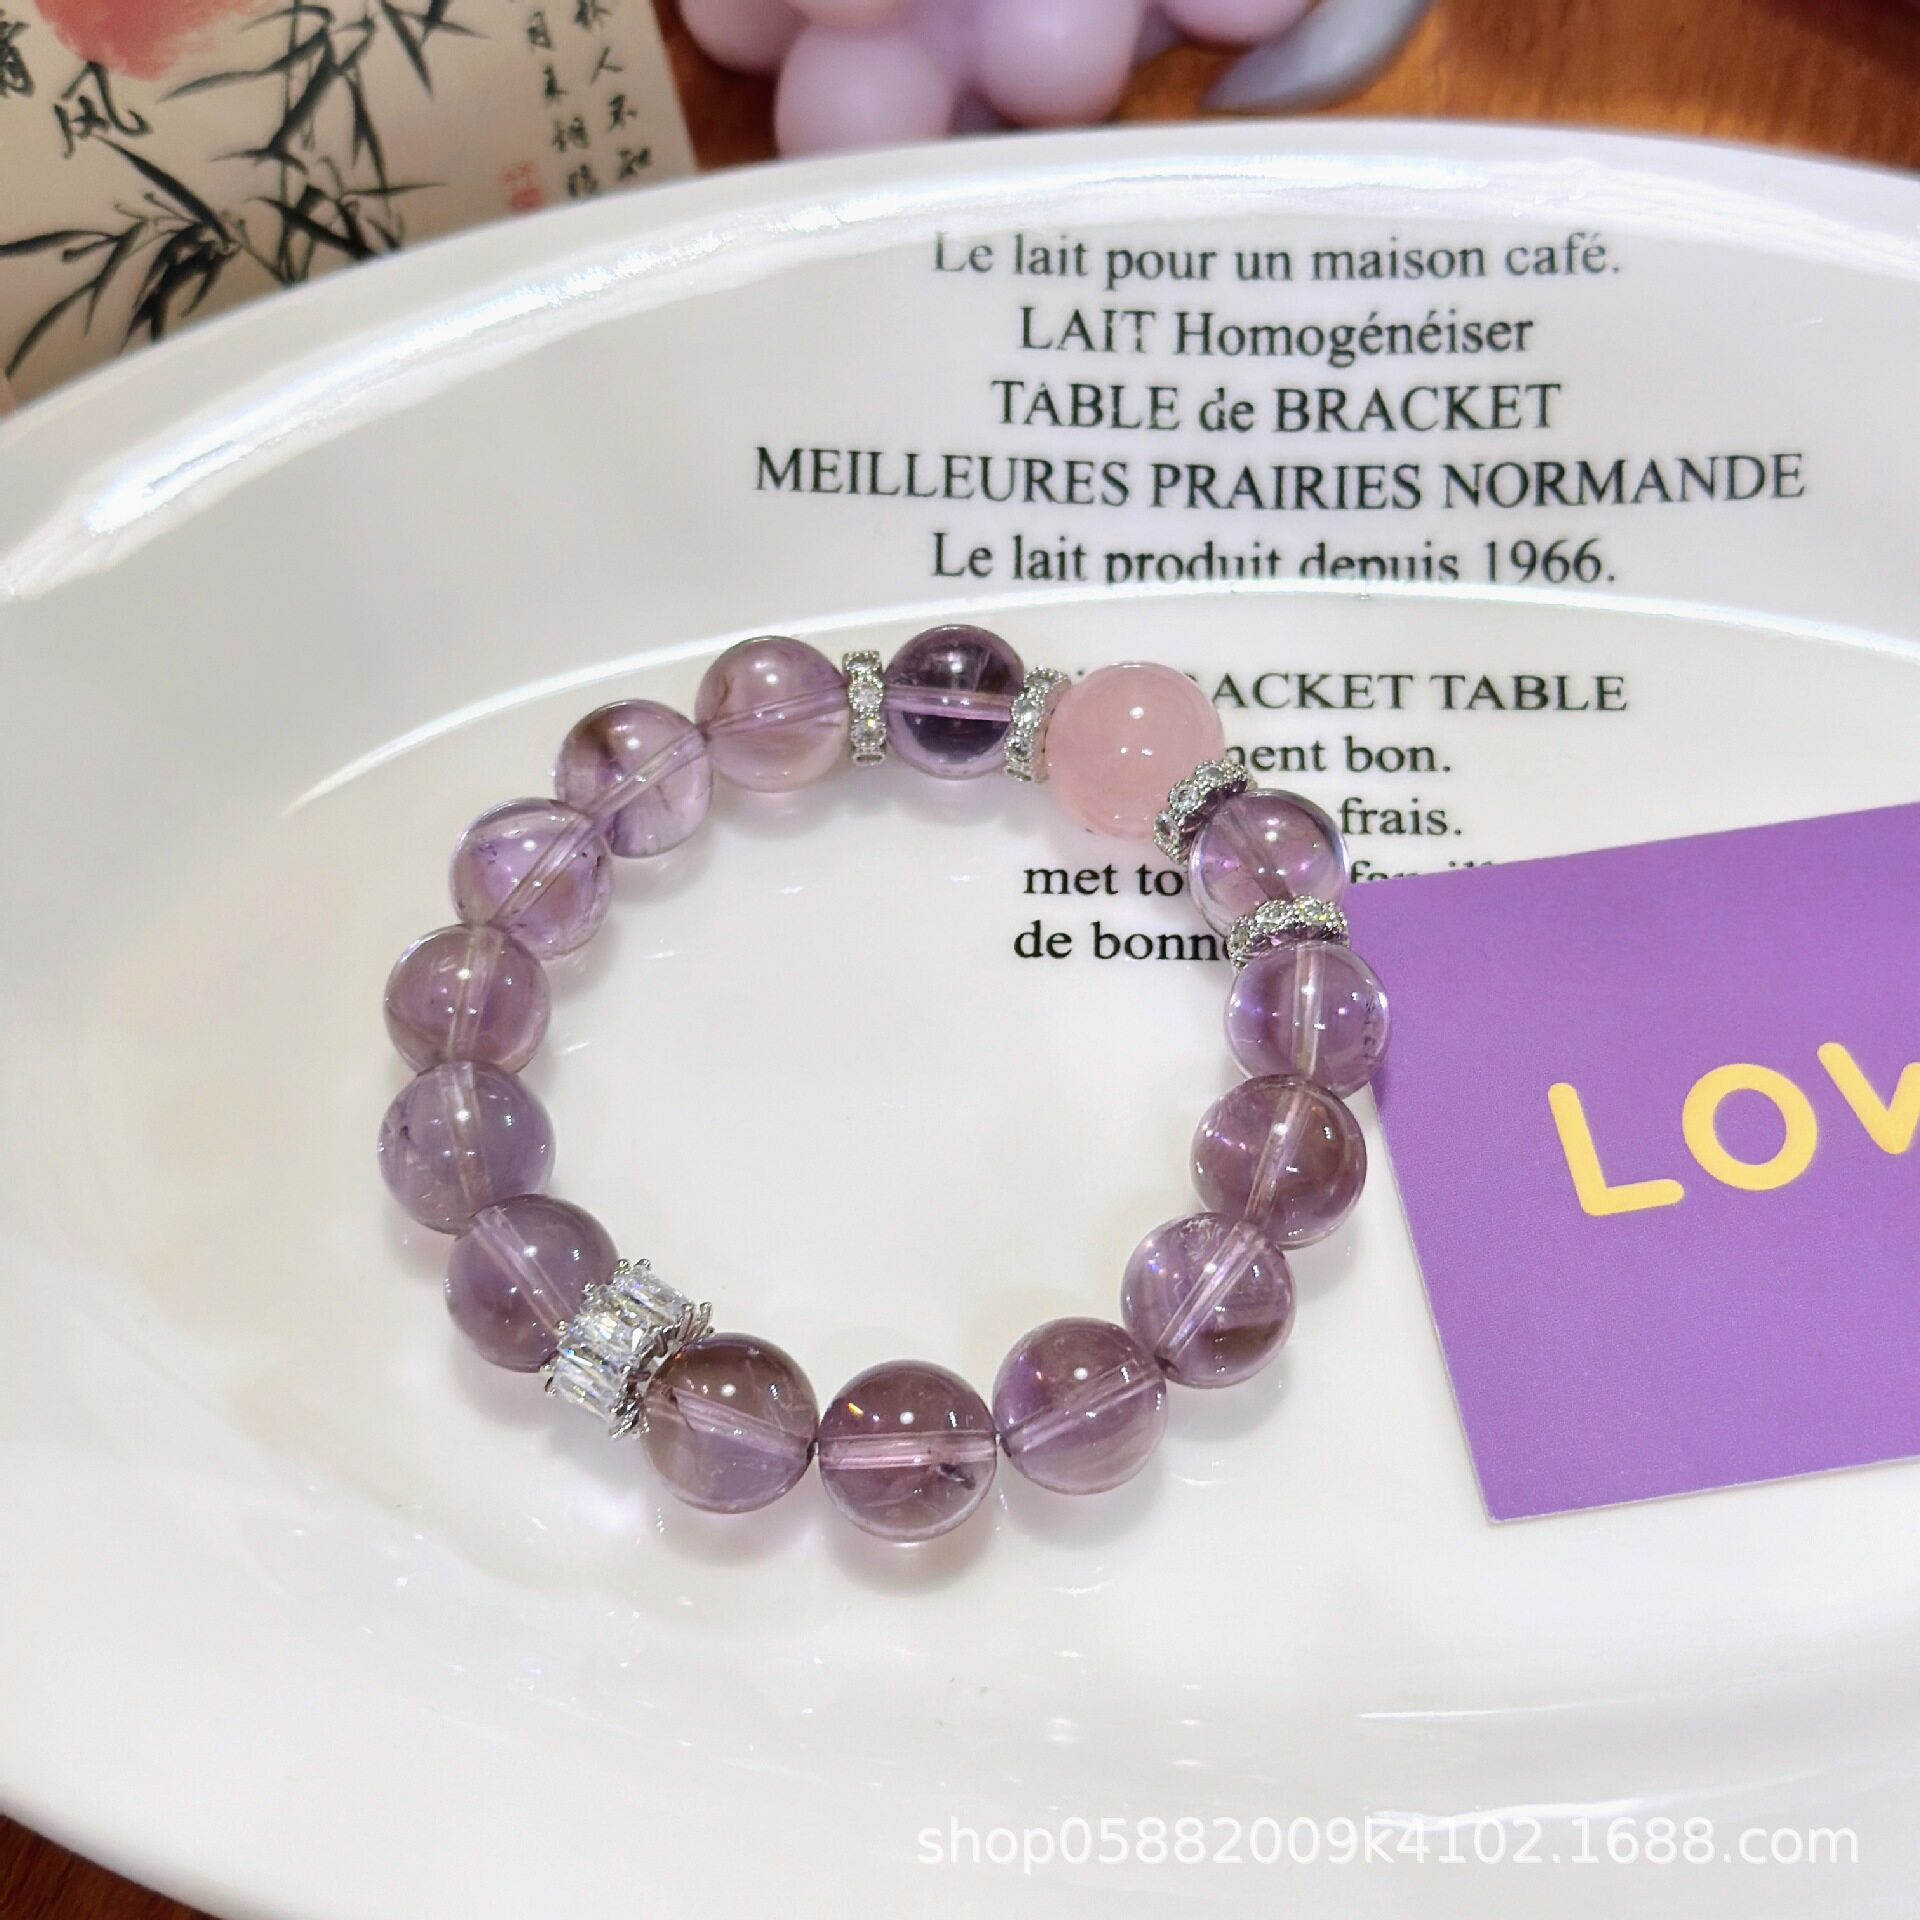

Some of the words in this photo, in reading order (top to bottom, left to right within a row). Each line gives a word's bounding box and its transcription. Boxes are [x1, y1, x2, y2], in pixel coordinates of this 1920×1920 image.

[934, 231, 993, 274] Le
[1013, 233, 1089, 277] lait
[1105, 247, 1219, 292] pour
[1234, 250, 1294, 282] un
[1311, 236, 1486, 281] maison
[1504, 231, 1622, 277] café.
[1019, 306, 1157, 354] LAIT
[1174, 308, 1535, 369] Homogénéiser
[990, 379, 1180, 431] TABLE
[1198, 386, 1256, 433] de
[1274, 383, 1563, 433] BRACKET
[755, 446, 1131, 508] MEILLEURES
[1150, 462, 1423, 511] PRAIRIES
[1440, 452, 1807, 510] NORMANDE
[931, 531, 994, 578] Le
[1012, 534, 1088, 582] lait
[1104, 540, 1282, 583] produit
[1299, 540, 1461, 582] depuis
[1484, 538, 1616, 585] 1966.
[1185, 672, 1415, 710] ACKET
[1429, 674, 1631, 712] TABLE
[1343, 734, 1453, 774] bon.
[1337, 797, 1463, 837] frais.
[1023, 863, 1120, 896] met
[1136, 863, 1189, 896] to
[1013, 919, 1073, 960] de
[1090, 920, 1231, 961] bonn
